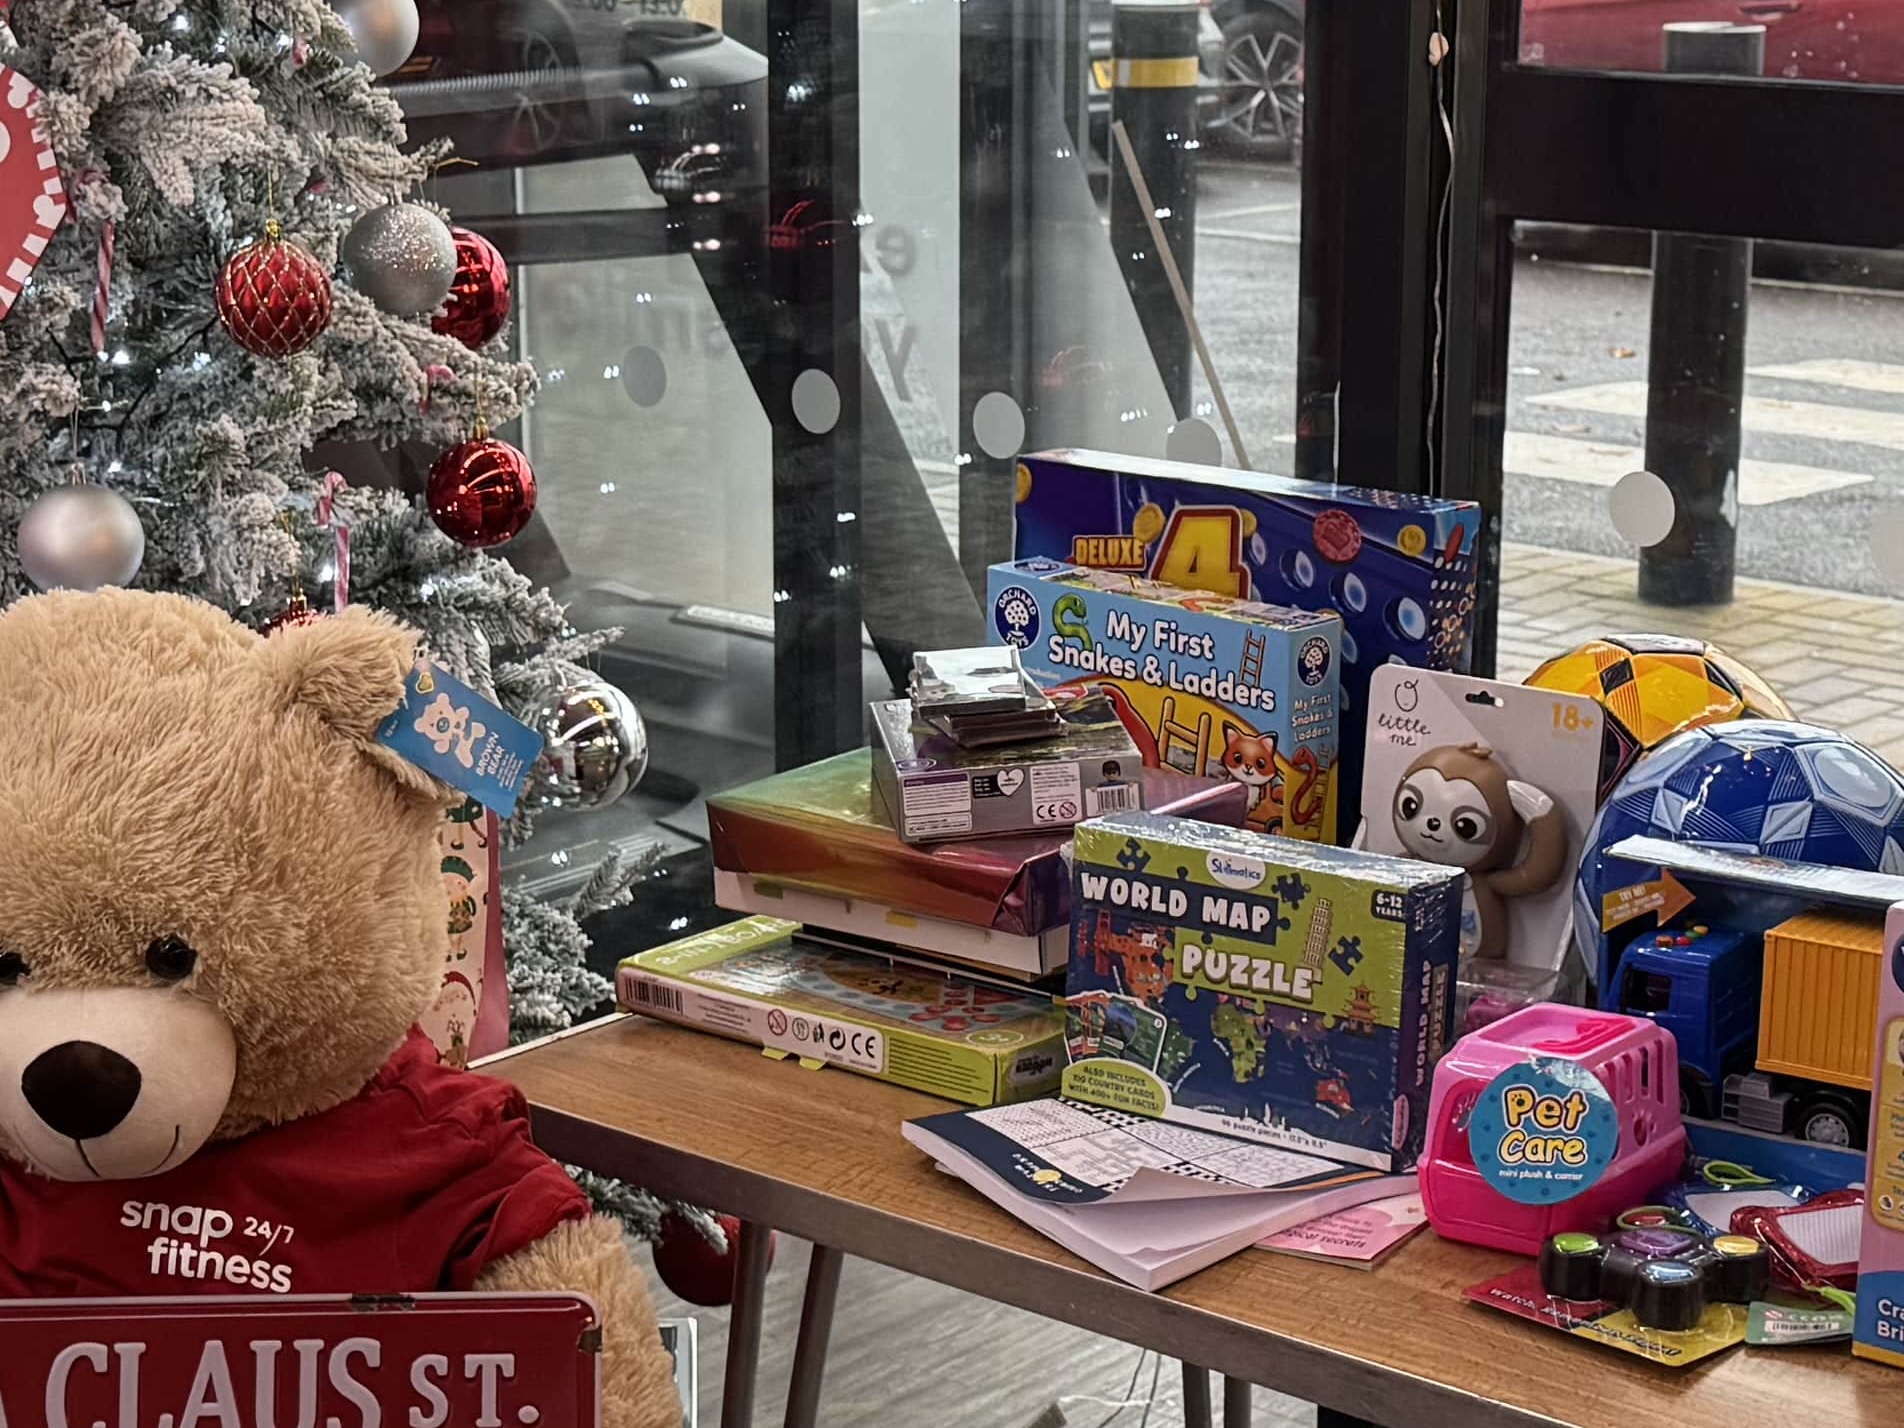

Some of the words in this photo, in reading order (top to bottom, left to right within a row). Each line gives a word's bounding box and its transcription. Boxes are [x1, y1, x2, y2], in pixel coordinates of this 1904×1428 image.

[1075, 535, 1146, 567] DELUXE
[997, 587, 1038, 617] ORCHARD
[1106, 609, 1146, 648] My
[1152, 619, 1216, 660] First
[1048, 635, 1137, 682] Snakes
[1142, 660, 1163, 687] &
[1168, 661, 1277, 712] Ladders
[1378, 713, 1432, 735] little
[1551, 703, 1594, 731] 18+
[475, 732, 500, 777] BROWN
[1389, 734, 1417, 746] me
[487, 745, 506, 775] BEAR
[1080, 871, 1189, 918] WORLD
[1201, 895, 1271, 933] MAP
[1375, 892, 1403, 909] 6-12
[1375, 906, 1405, 918] YEARS
[1180, 942, 1315, 1002] PUZZLE
[1501, 1084, 1589, 1132] Pet
[1498, 1131, 1588, 1166] Care
[1498, 1169, 1518, 1179] mini
[1519, 1169, 1544, 1180] plush
[120, 1200, 234, 1248] snap
[242, 1216, 295, 1257] 24/7
[147, 1236, 293, 1294] fitness
